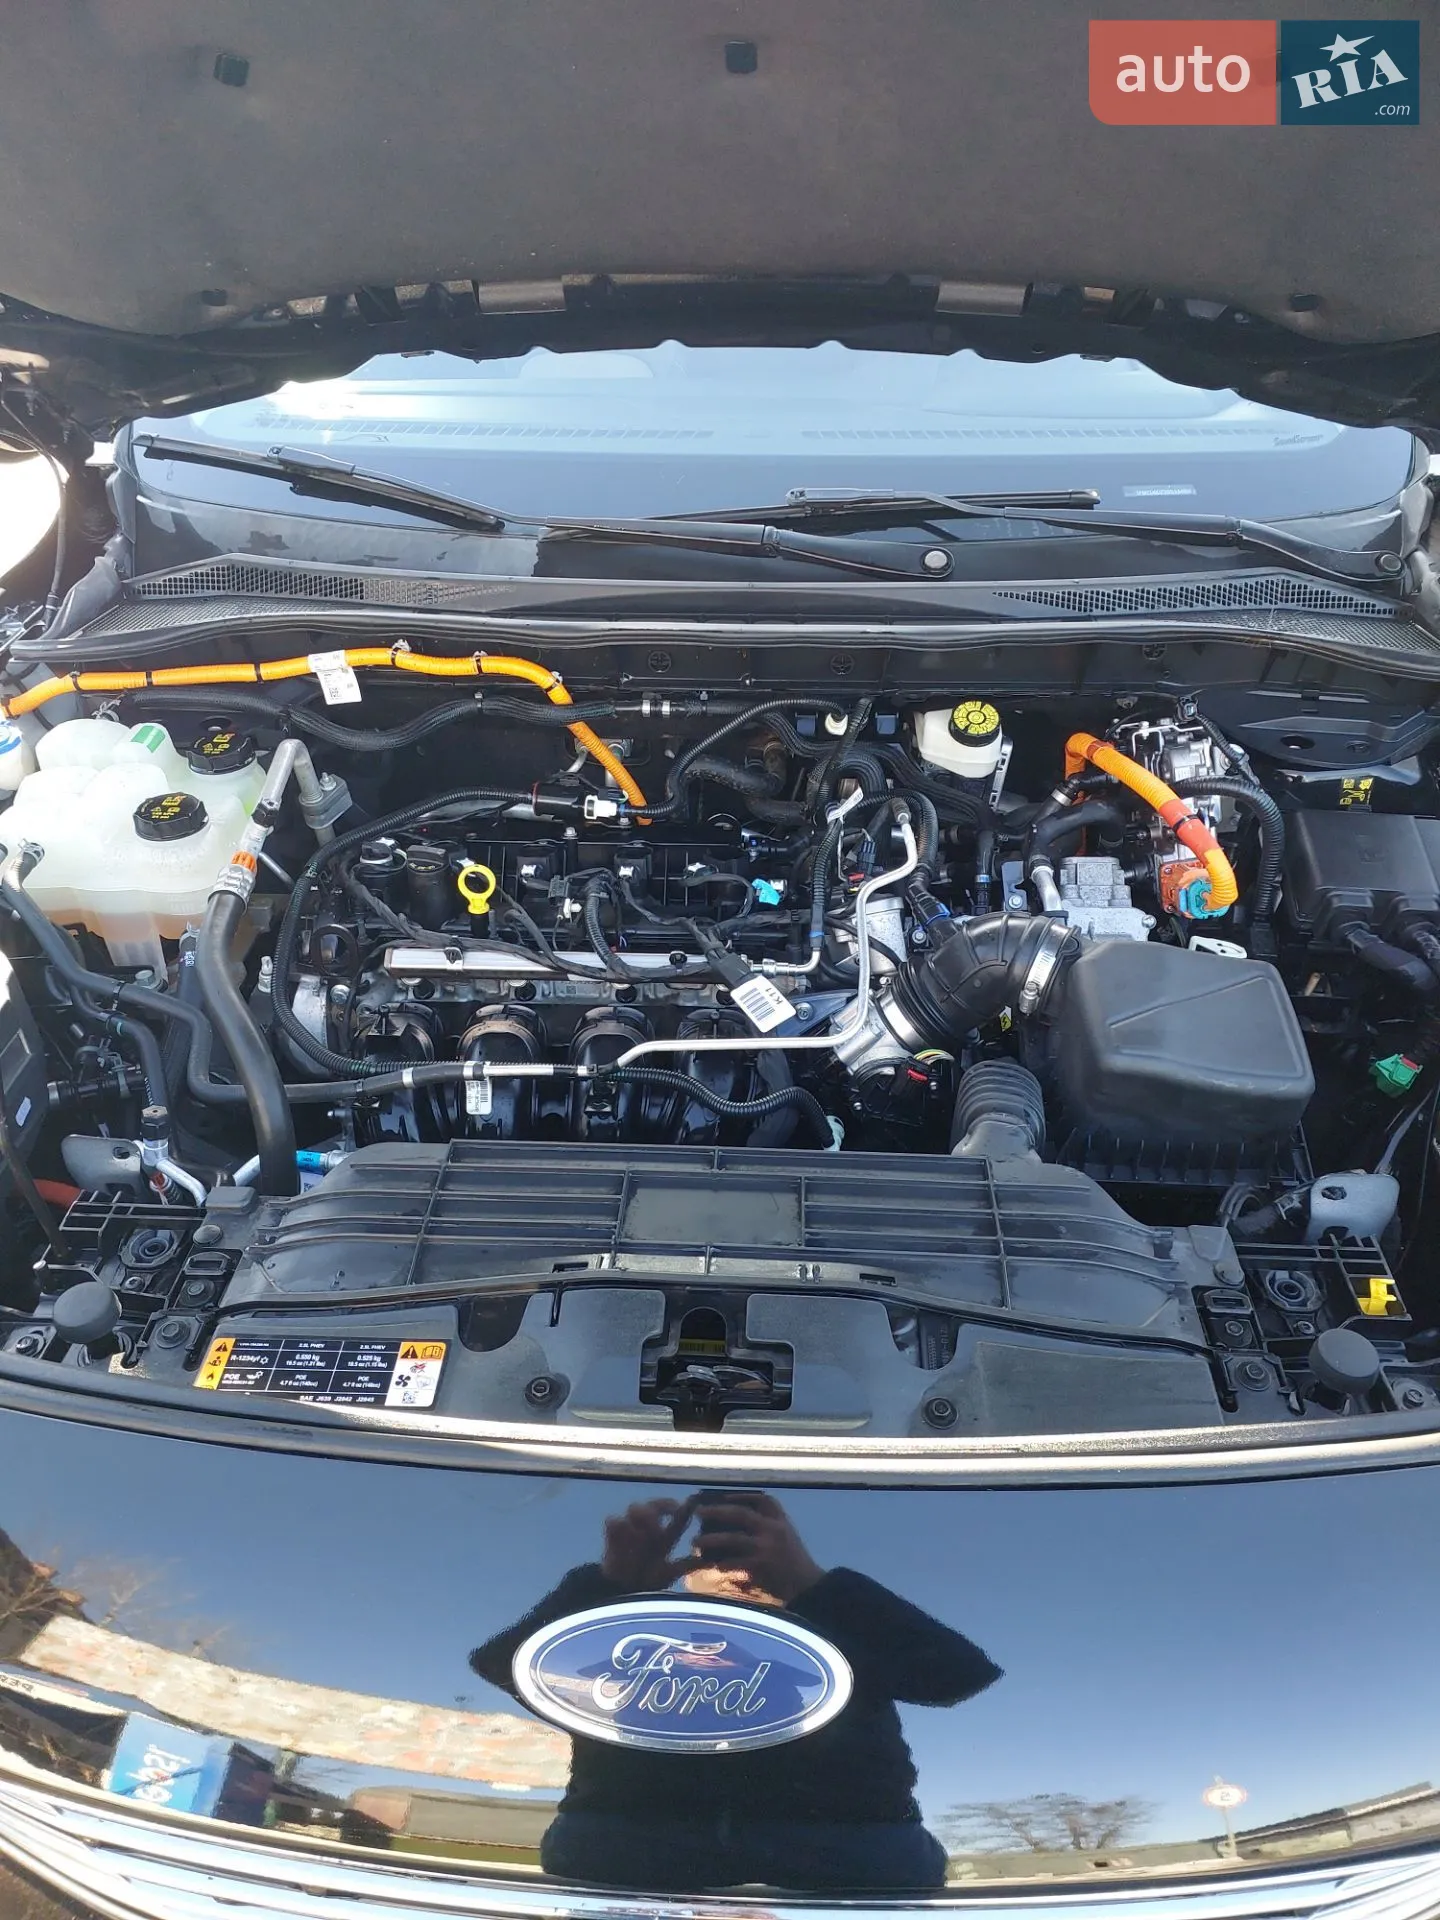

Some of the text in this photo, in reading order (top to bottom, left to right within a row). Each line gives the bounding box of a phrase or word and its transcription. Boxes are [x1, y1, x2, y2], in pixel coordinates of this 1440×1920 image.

[764, 987, 784, 1005] K11
[230, 1354, 261, 1362] R-1234yf
[590, 1633, 772, 1717] Ford
